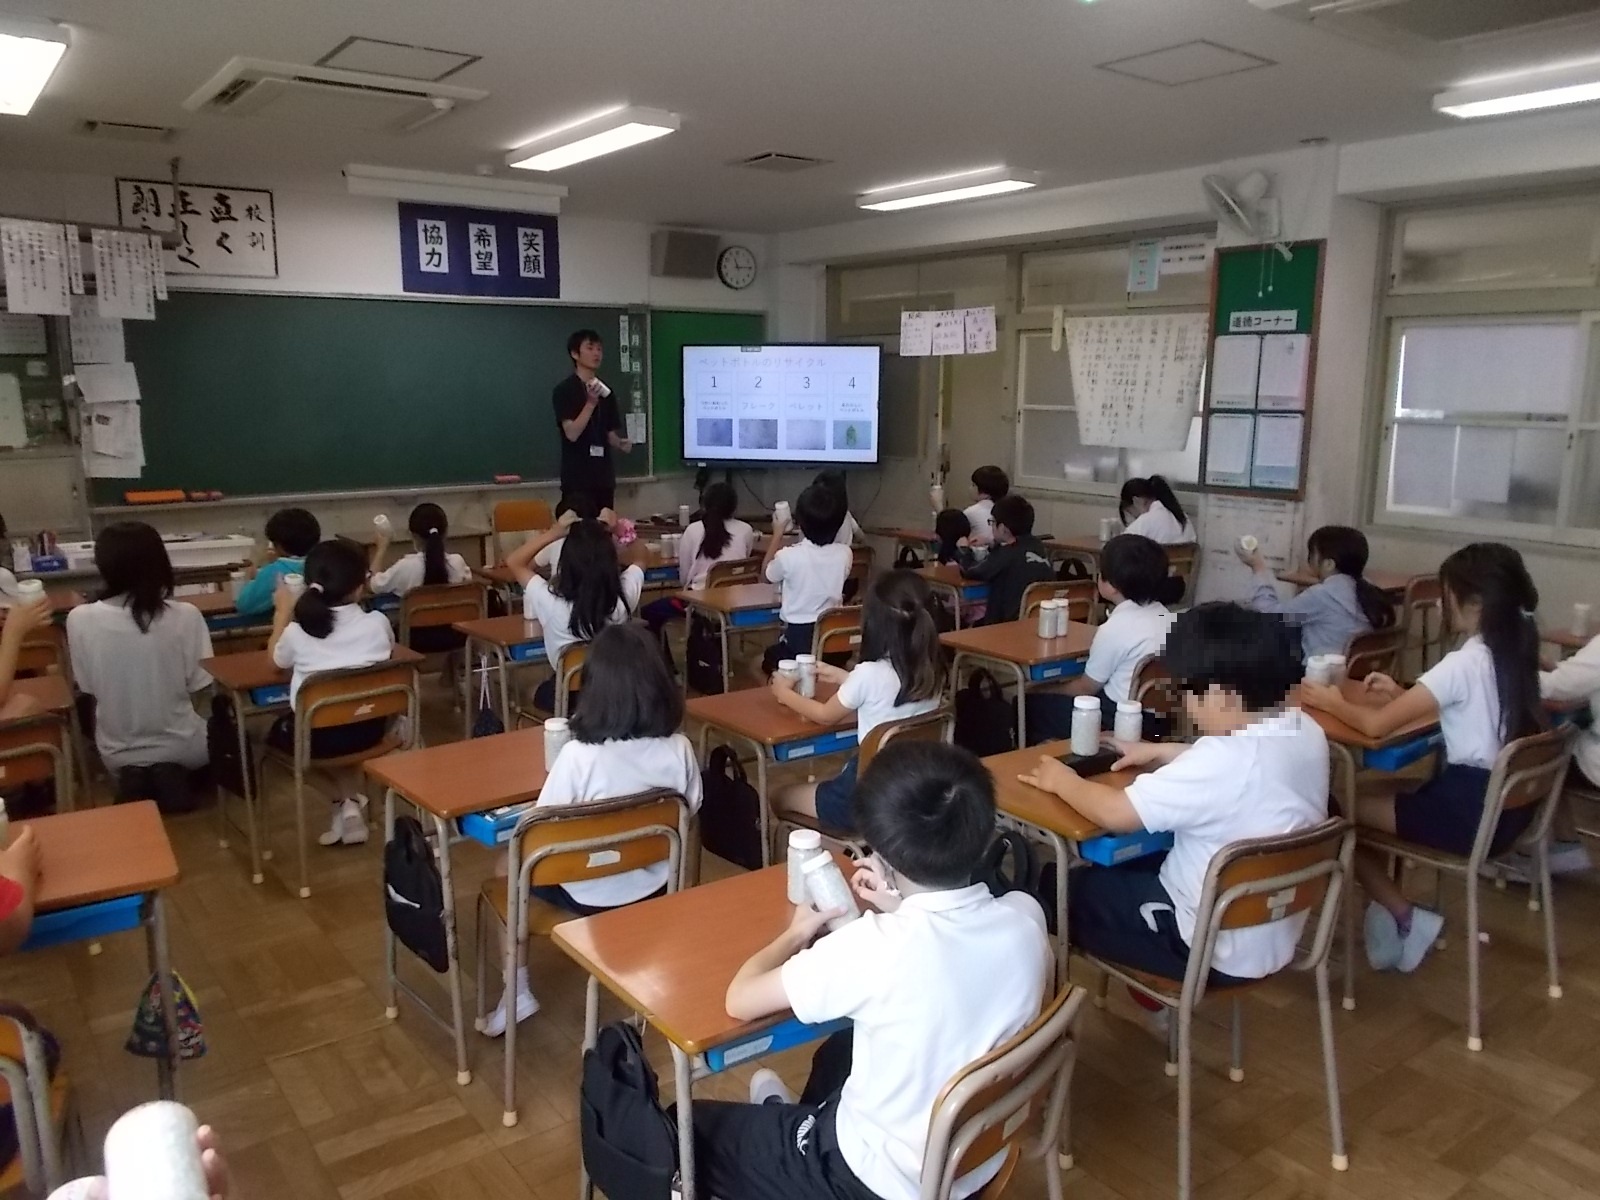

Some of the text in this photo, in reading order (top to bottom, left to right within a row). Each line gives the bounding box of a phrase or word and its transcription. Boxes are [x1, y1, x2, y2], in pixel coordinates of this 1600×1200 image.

[245, 203, 266, 251] 校訓
[421, 223, 443, 268] 協力
[473, 226, 495, 271] 希望
[521, 230, 542, 275] 笑顔
[1231, 315, 1294, 328] 道徳コーナー
[698, 356, 827, 368] ペットボトルのリサイクル
[711, 375, 718, 388] 1
[754, 376, 762, 388] 2
[803, 377, 811, 389] 3
[848, 377, 856, 389] 4
[741, 401, 776, 410] フレーク
